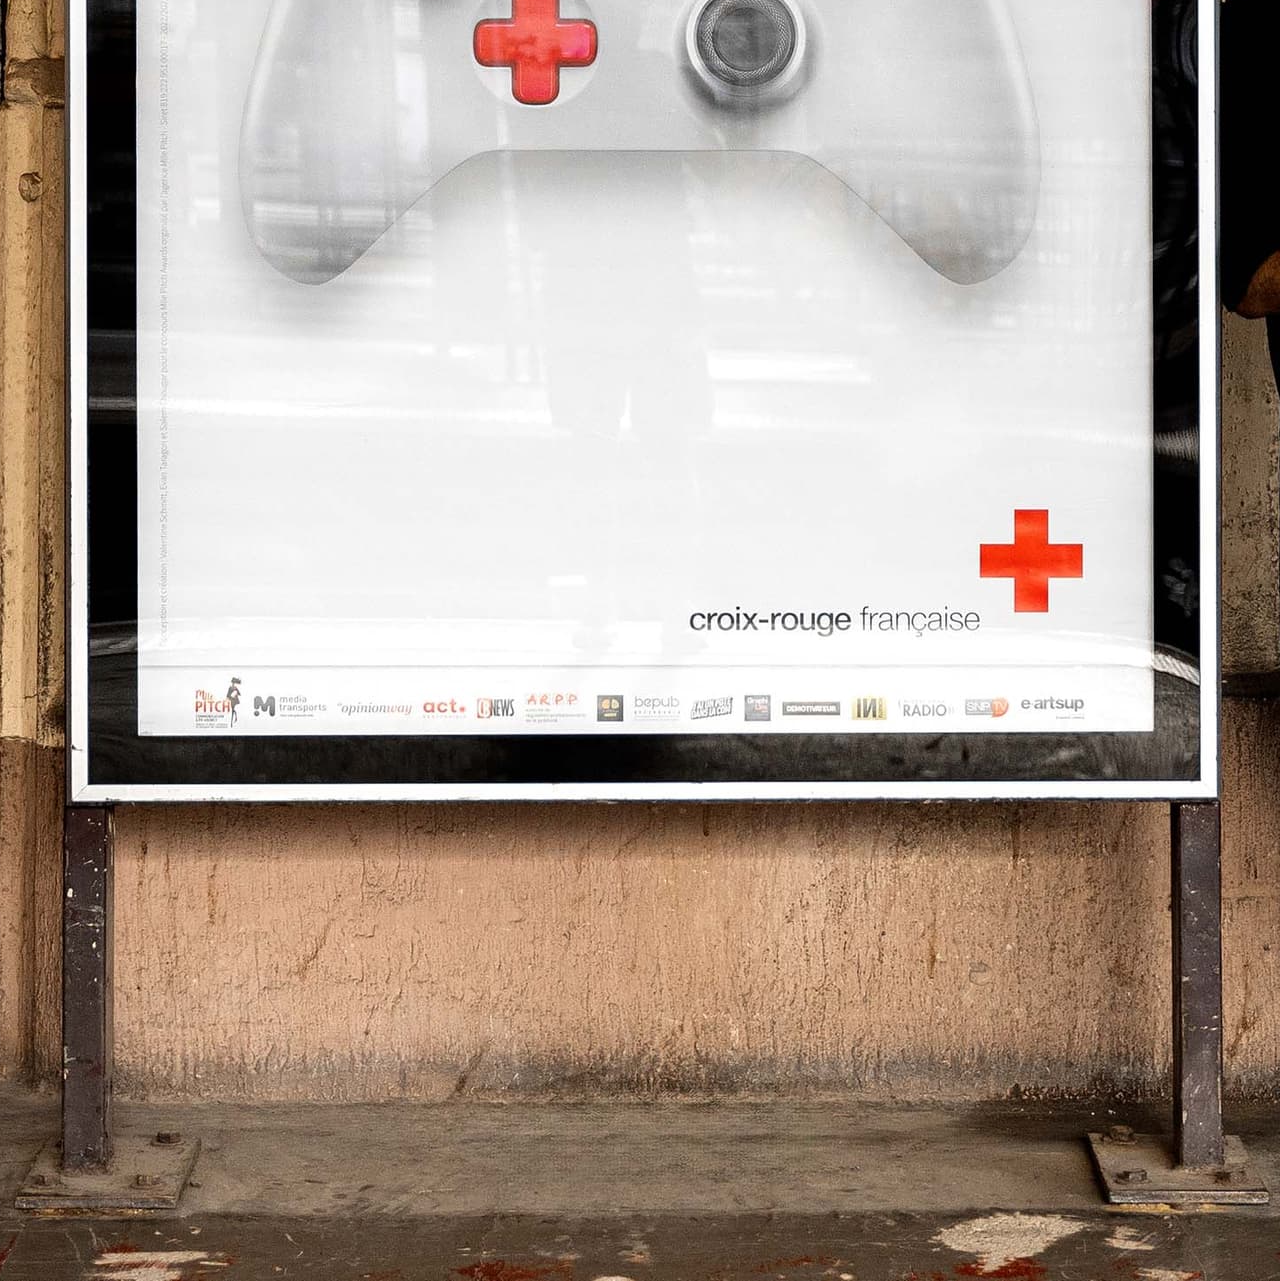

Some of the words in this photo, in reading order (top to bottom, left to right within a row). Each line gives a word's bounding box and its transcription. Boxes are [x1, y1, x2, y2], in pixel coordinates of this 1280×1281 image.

[689, 606, 851, 637] croix-rouge
[859, 605, 981, 637] française
[279, 695, 308, 704] media
[634, 696, 680, 710] bepub
[195, 700, 231, 713] PITCH
[279, 703, 328, 713] transports
[903, 703, 947, 717] RADIO
